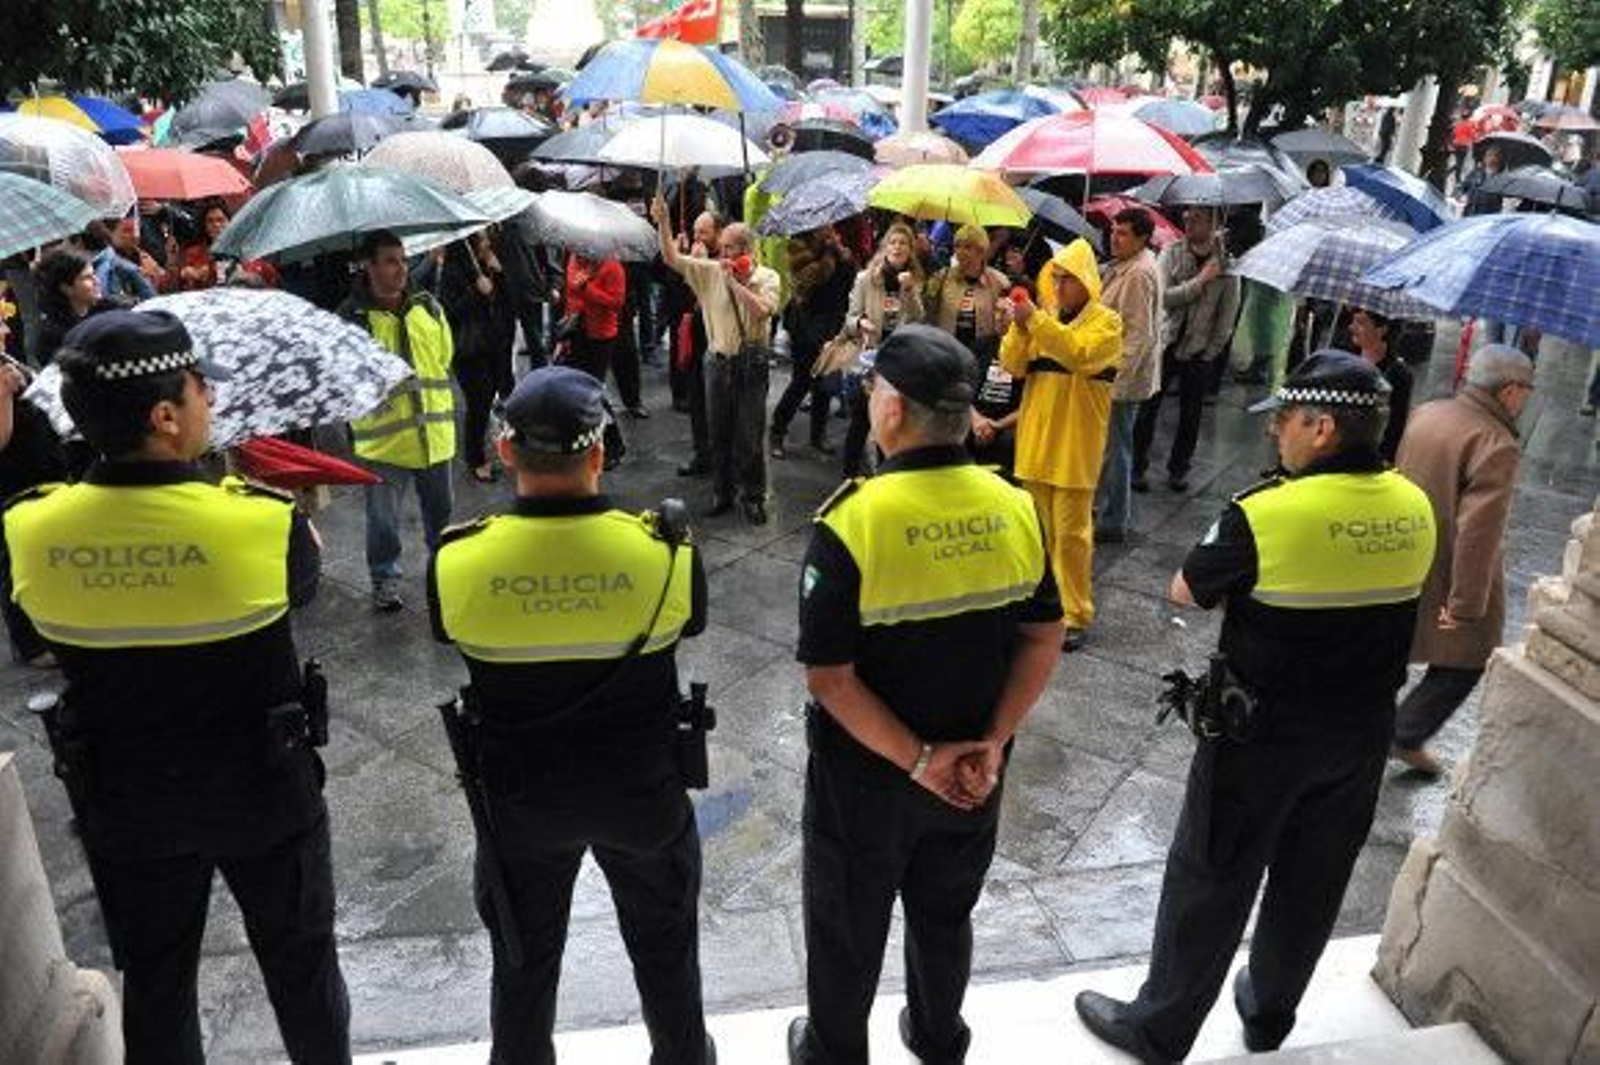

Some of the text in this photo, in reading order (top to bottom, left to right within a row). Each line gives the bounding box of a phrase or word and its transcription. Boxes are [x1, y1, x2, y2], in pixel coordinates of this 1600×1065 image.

[47, 545, 208, 568] POLICIA
[933, 540, 994, 560] LOCAL
[82, 572, 176, 588] LOCAL
[490, 573, 634, 597] POLICIA
[523, 598, 605, 615] LOCAL
